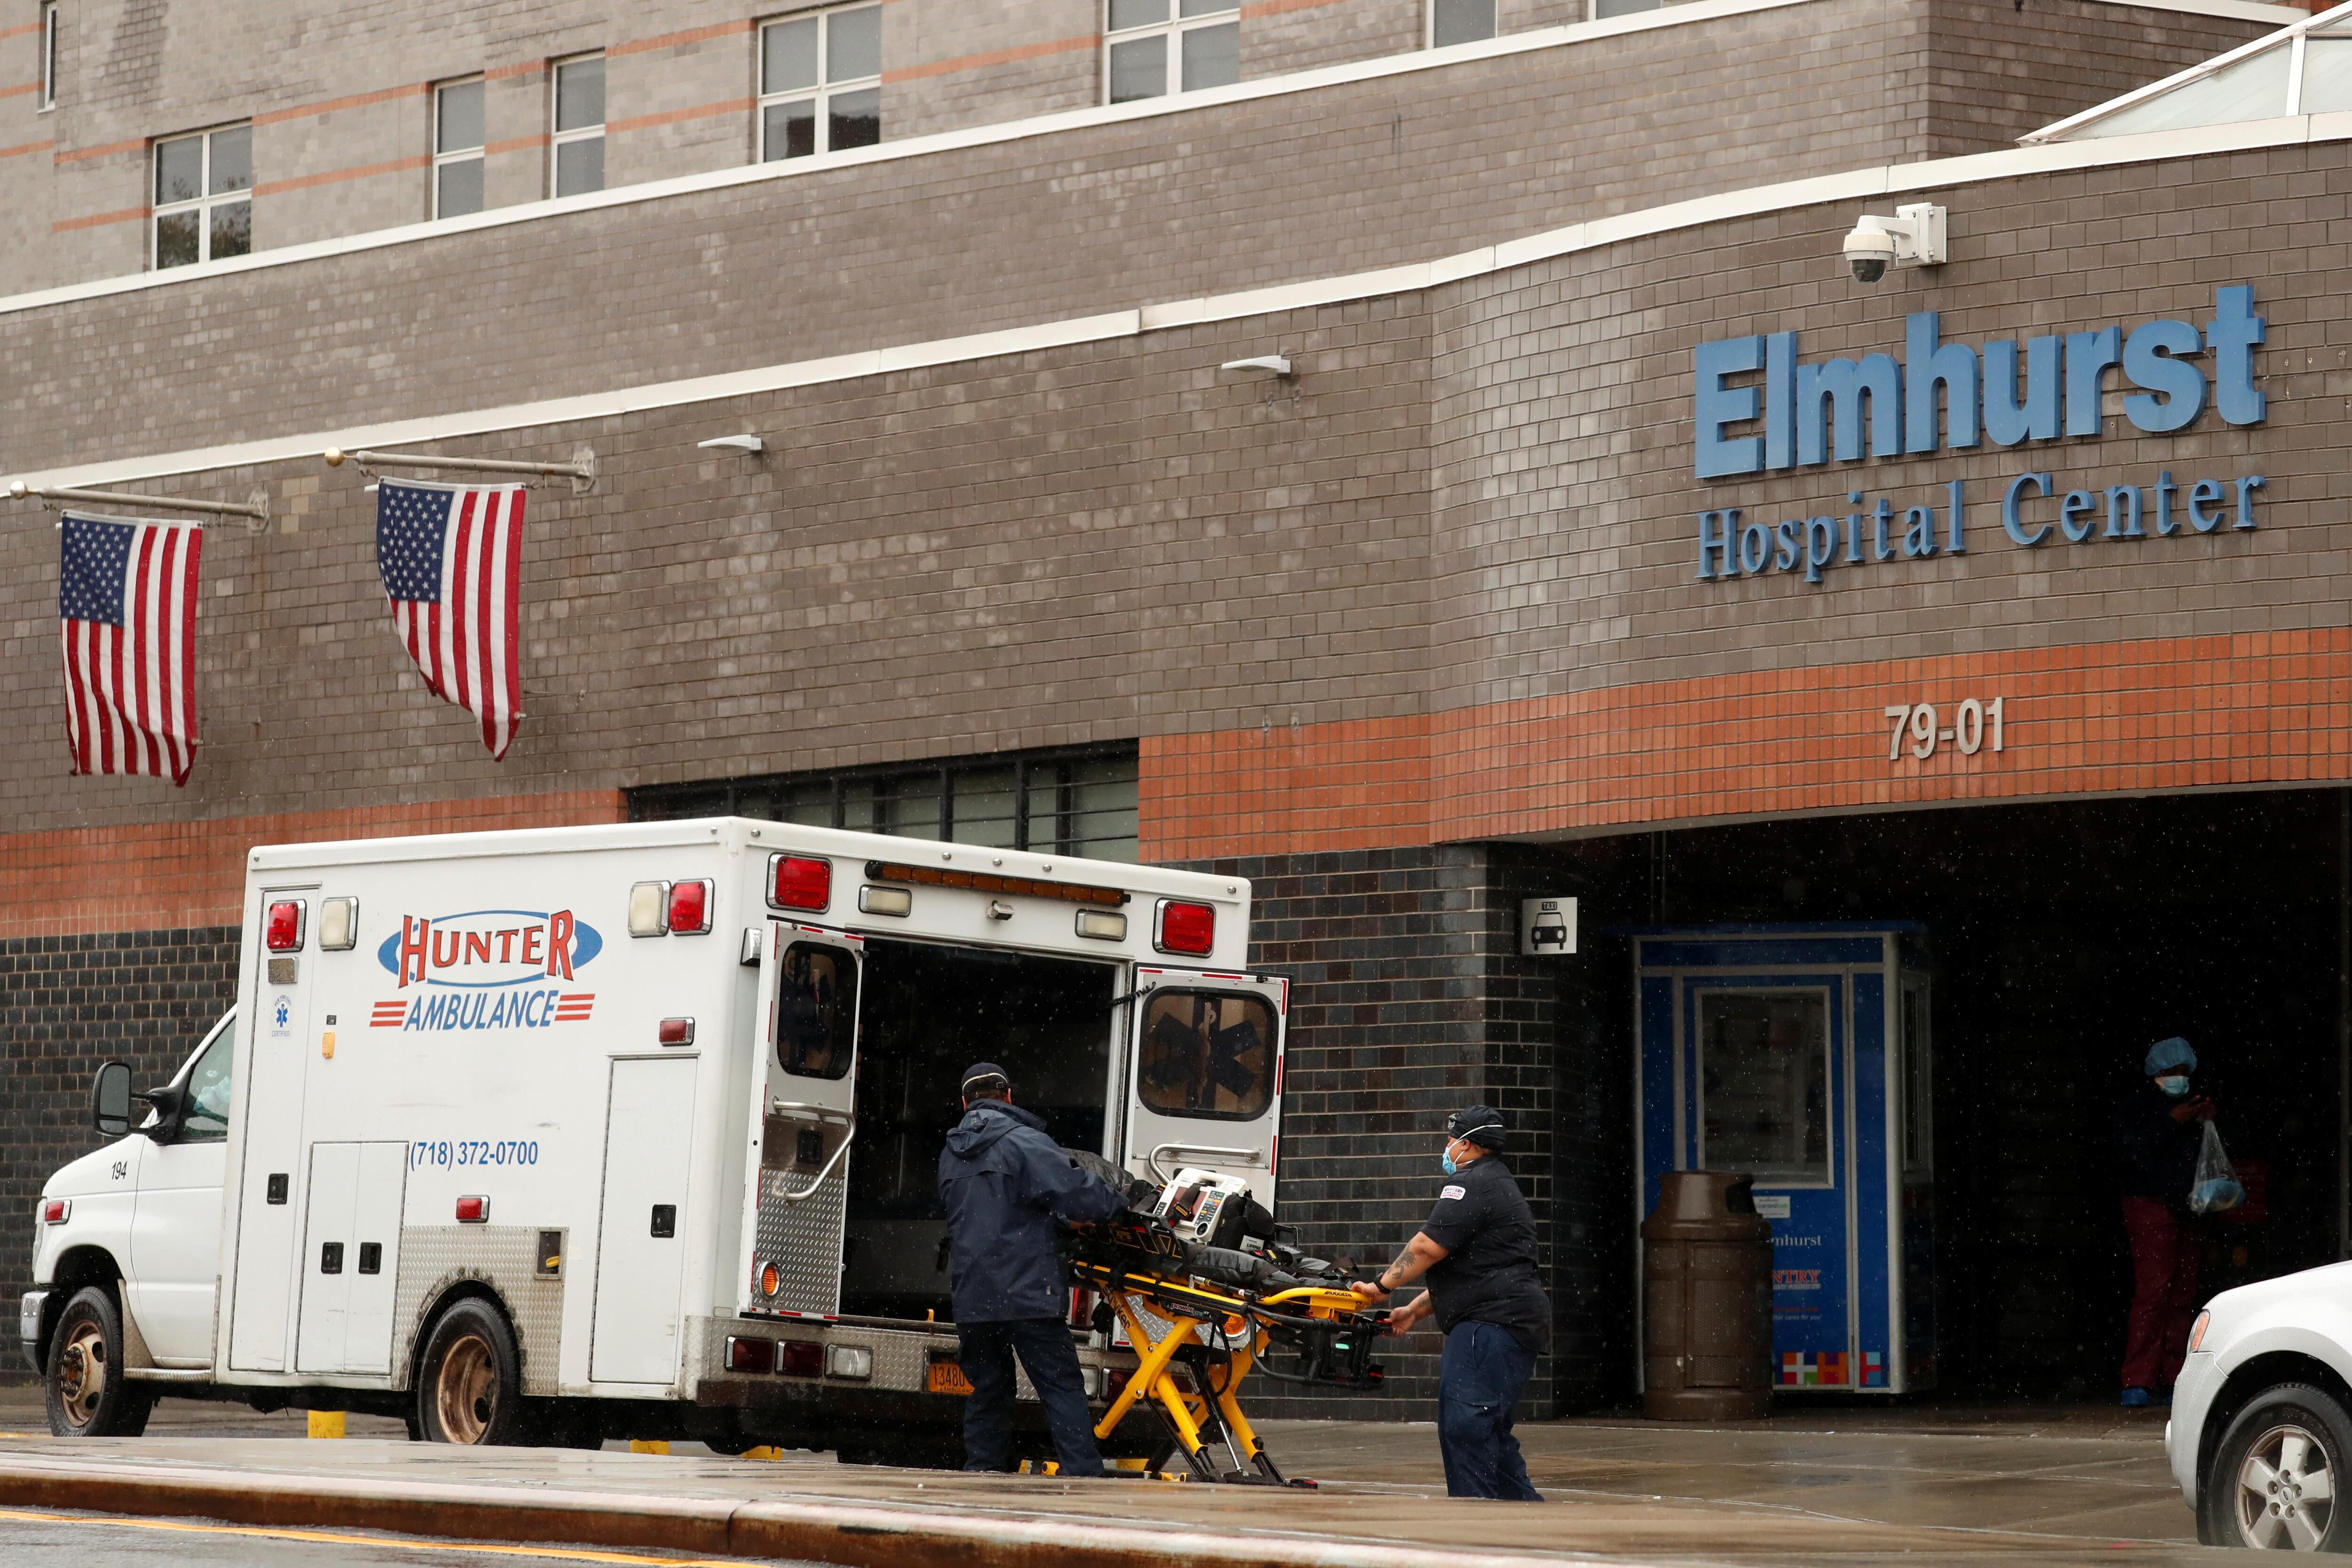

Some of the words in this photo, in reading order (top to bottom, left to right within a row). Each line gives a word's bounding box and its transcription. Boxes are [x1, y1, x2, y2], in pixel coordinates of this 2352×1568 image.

[1695, 284, 2265, 479] Elmhurst
[1695, 479, 1966, 582] Hospital
[2002, 470, 2265, 546] Center
[1884, 696, 2004, 760] 79-01
[398, 909, 574, 988] HUNTER
[403, 989, 559, 1031] AMBULANCE
[111, 1160, 127, 1180] 194
[410, 1141, 453, 1172] (718)
[458, 1141, 538, 1165] 372-0700
[1771, 1234, 1822, 1246] mhurst
[1772, 1269, 1821, 1283] NTRY
